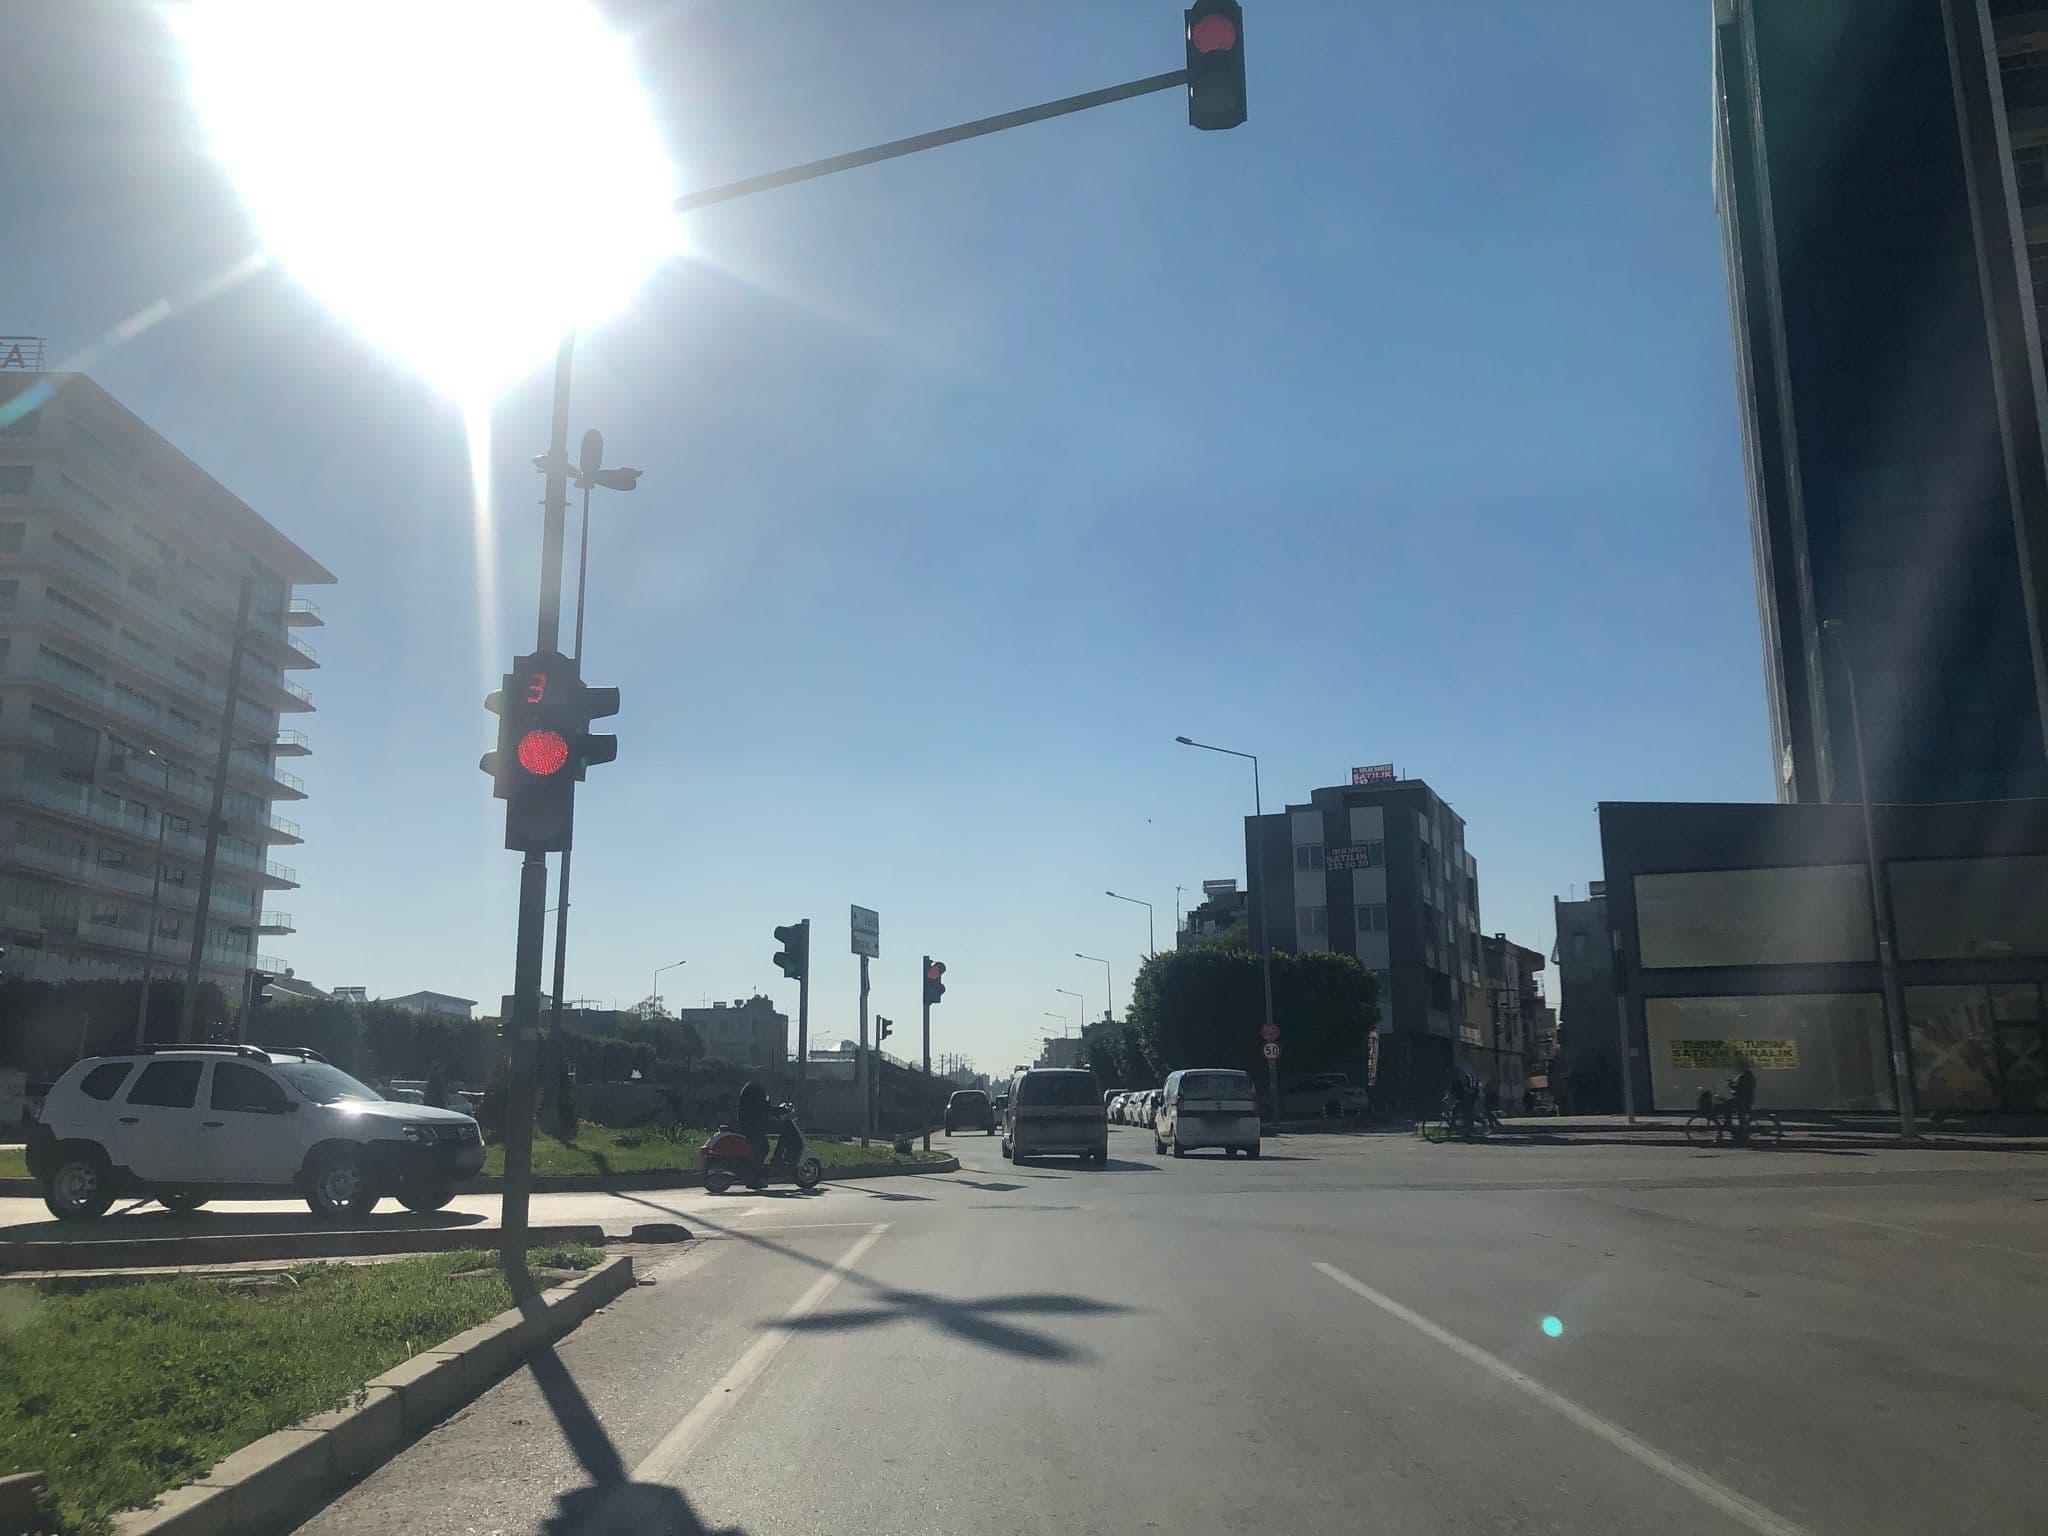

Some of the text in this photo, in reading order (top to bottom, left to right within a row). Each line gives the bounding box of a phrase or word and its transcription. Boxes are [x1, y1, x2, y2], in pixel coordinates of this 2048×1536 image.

[527, 673, 546, 703] 3
[1353, 771, 1392, 781] SATILIK
[1326, 852, 1367, 863] SATILIK
[1266, 1046, 1278, 1056] 50
